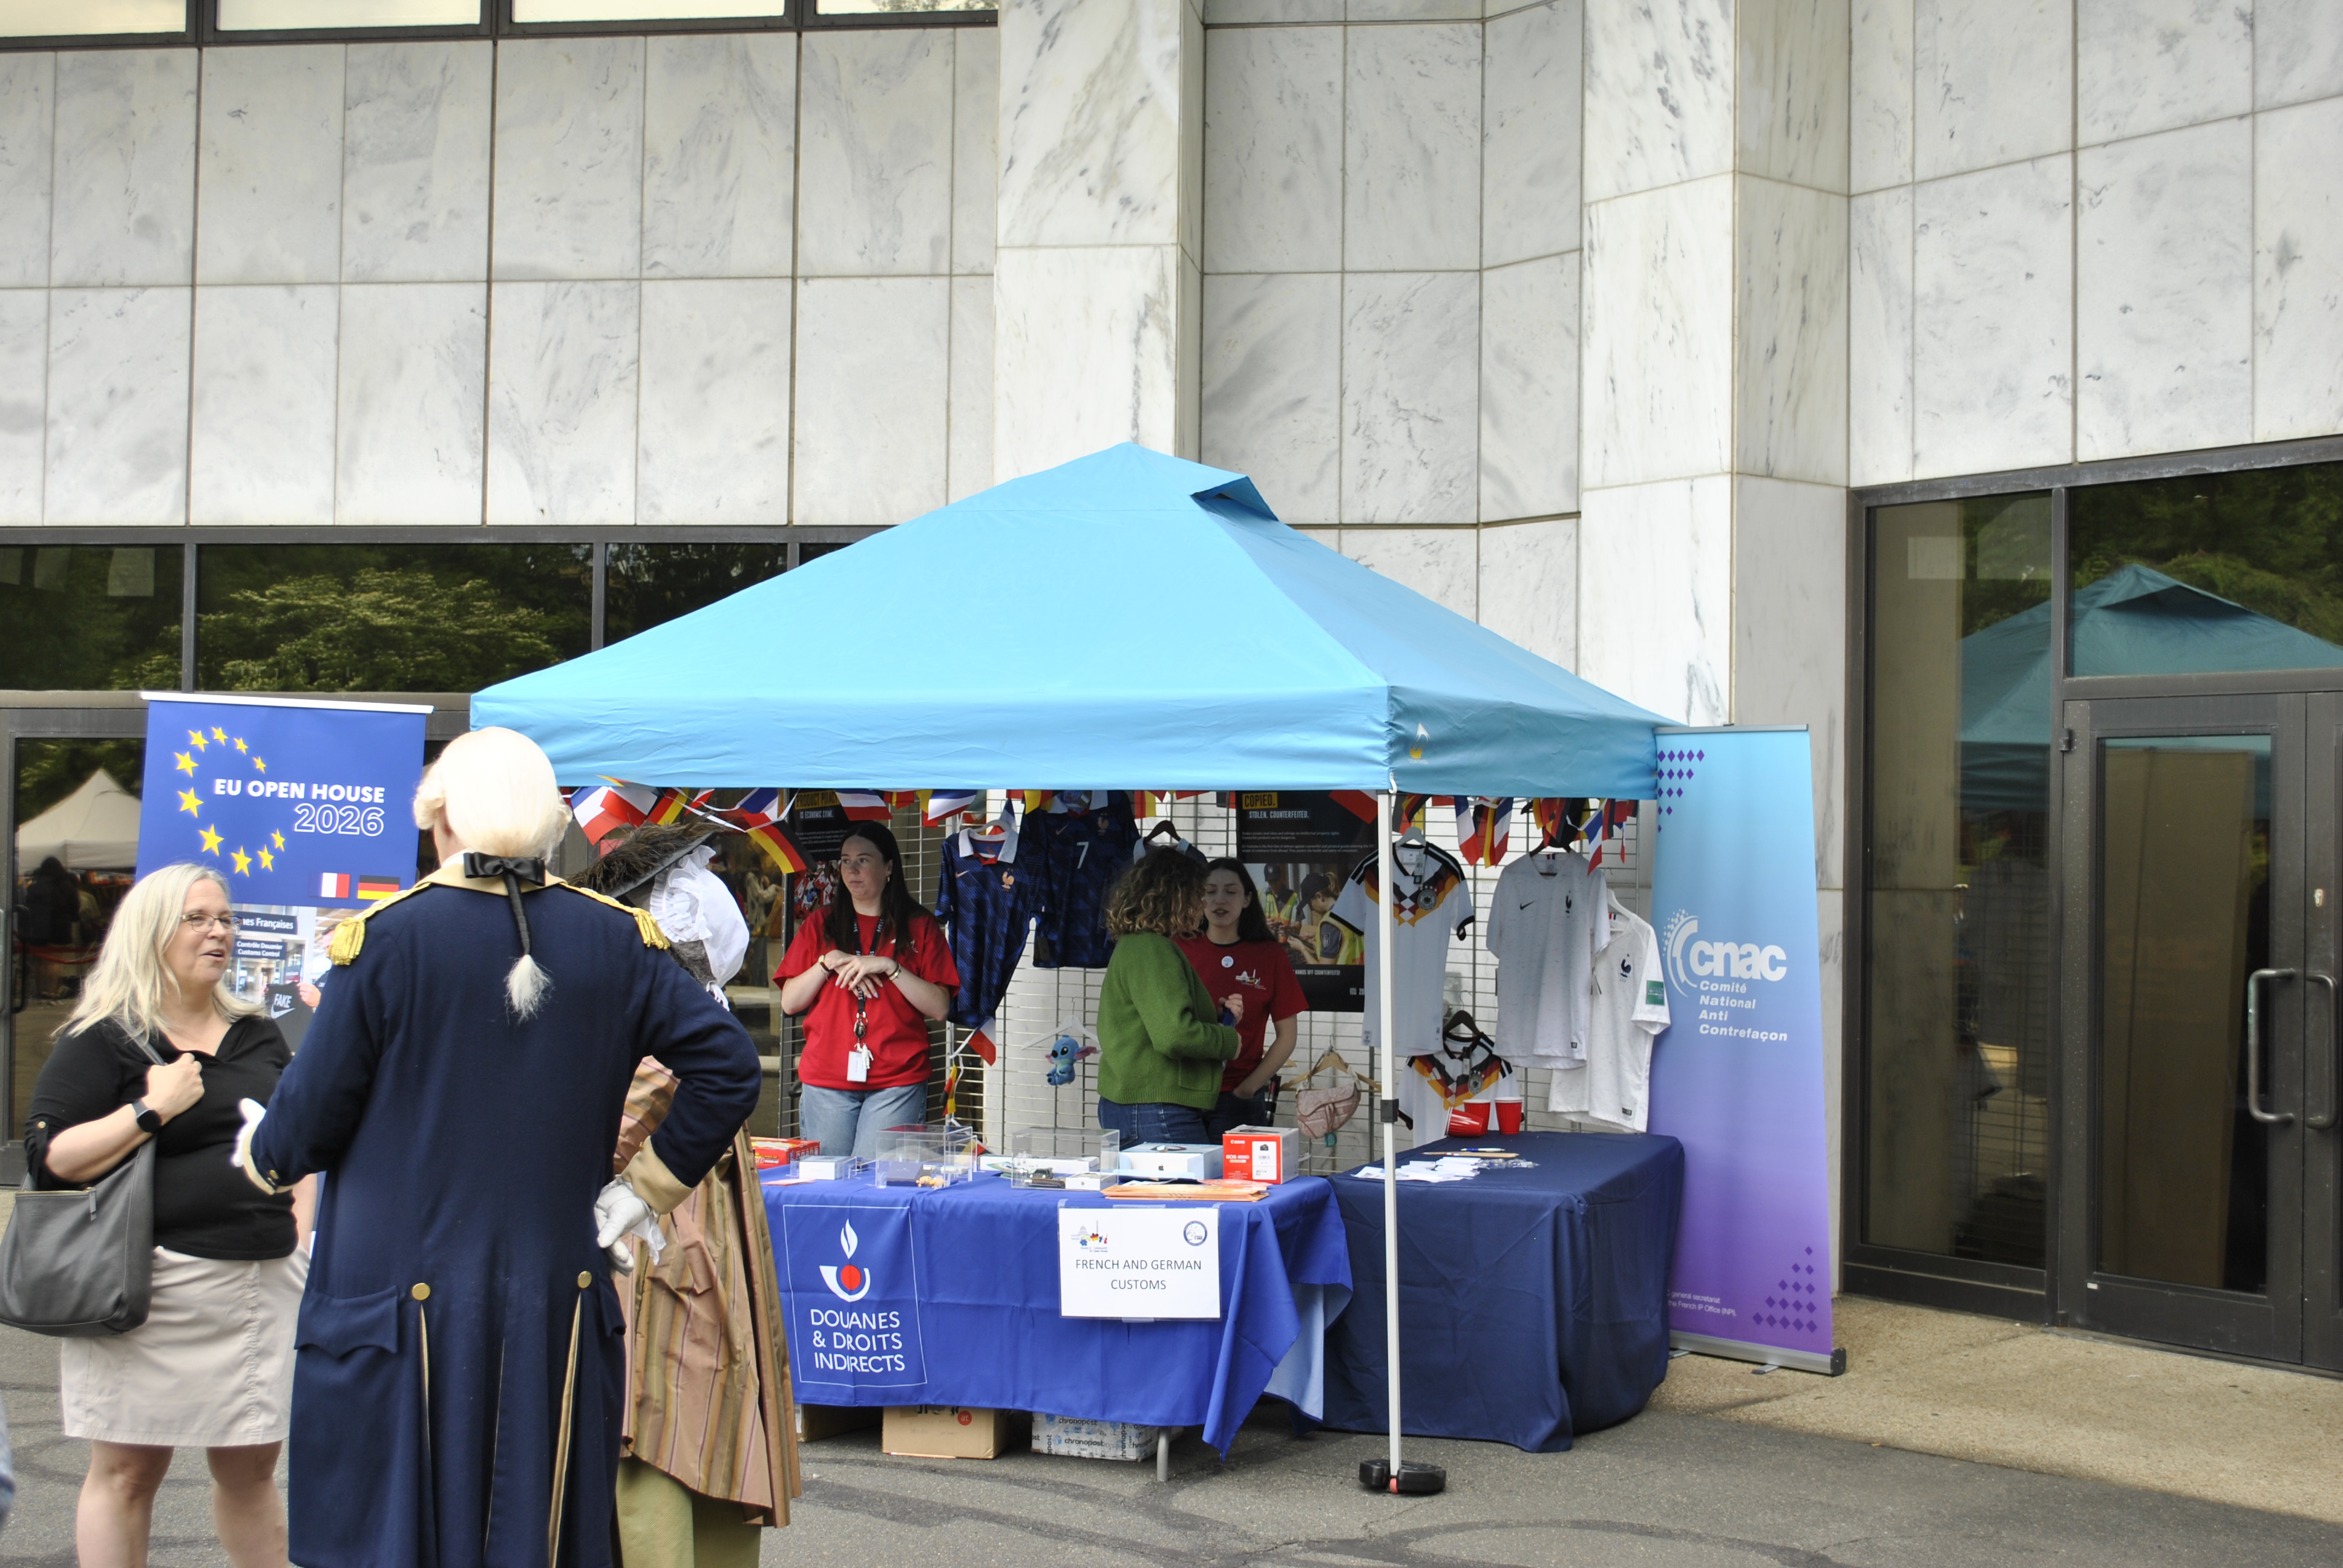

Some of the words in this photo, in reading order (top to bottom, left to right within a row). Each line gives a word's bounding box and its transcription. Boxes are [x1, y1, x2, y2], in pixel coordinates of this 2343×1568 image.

[215, 779, 241, 795] EU
[247, 780, 305, 799] OPEN
[312, 783, 385, 803] HOUSE
[796, 793, 819, 808] PRODUCT
[1244, 794, 1276, 807] COPIED.
[294, 803, 385, 837] 2026
[1076, 841, 1089, 869] 7
[257, 918, 293, 930] Françaises
[1689, 940, 1788, 982] cnac
[1700, 980, 1747, 993] Comité
[274, 993, 292, 1008] FAKE
[1699, 995, 1757, 1009] National
[1699, 1009, 1728, 1021] Anti
[1699, 1024, 1788, 1042] Contrefaçon
[1076, 1259, 1119, 1269] FRENCH
[1123, 1259, 1148, 1269] AND
[1151, 1259, 1201, 1270] GERMAN
[1111, 1279, 1166, 1290] CUSTOMS
[1678, 1301, 1697, 1310] French
[1705, 1305, 1721, 1314] Office
[811, 1309, 900, 1330] DOUANES
[813, 1330, 827, 1347] &
[833, 1332, 902, 1351] DROITS
[814, 1352, 905, 1373] INDIRECTS
[1059, 1417, 1098, 1426] chronopost
[1064, 1437, 1104, 1446] chronopost
